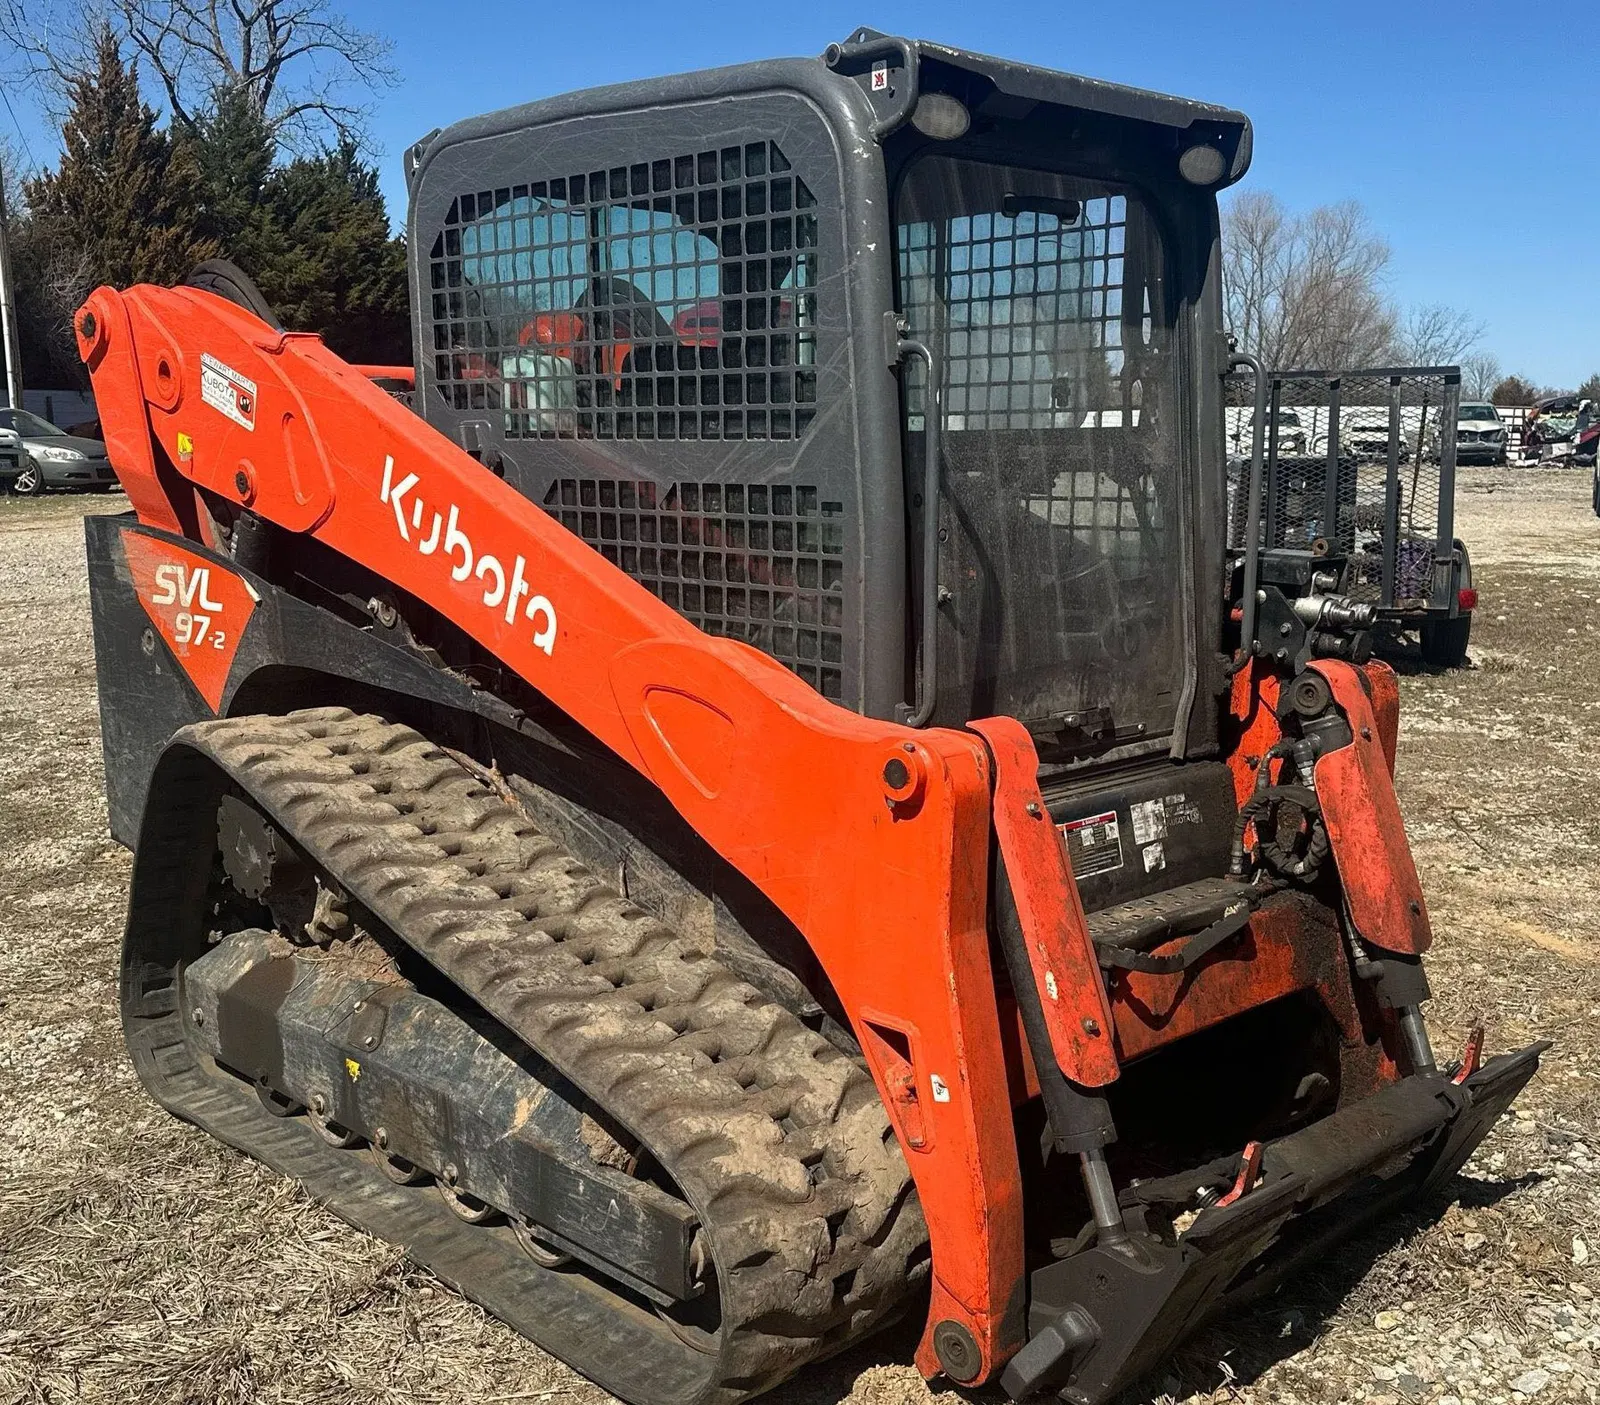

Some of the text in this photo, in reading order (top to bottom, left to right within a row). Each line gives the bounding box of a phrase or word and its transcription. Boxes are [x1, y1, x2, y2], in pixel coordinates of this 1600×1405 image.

[201, 368, 235, 400] KUBOTA
[202, 354, 230, 374] STEWART
[379, 454, 558, 657] Kubota
[152, 564, 223, 612] SVL
